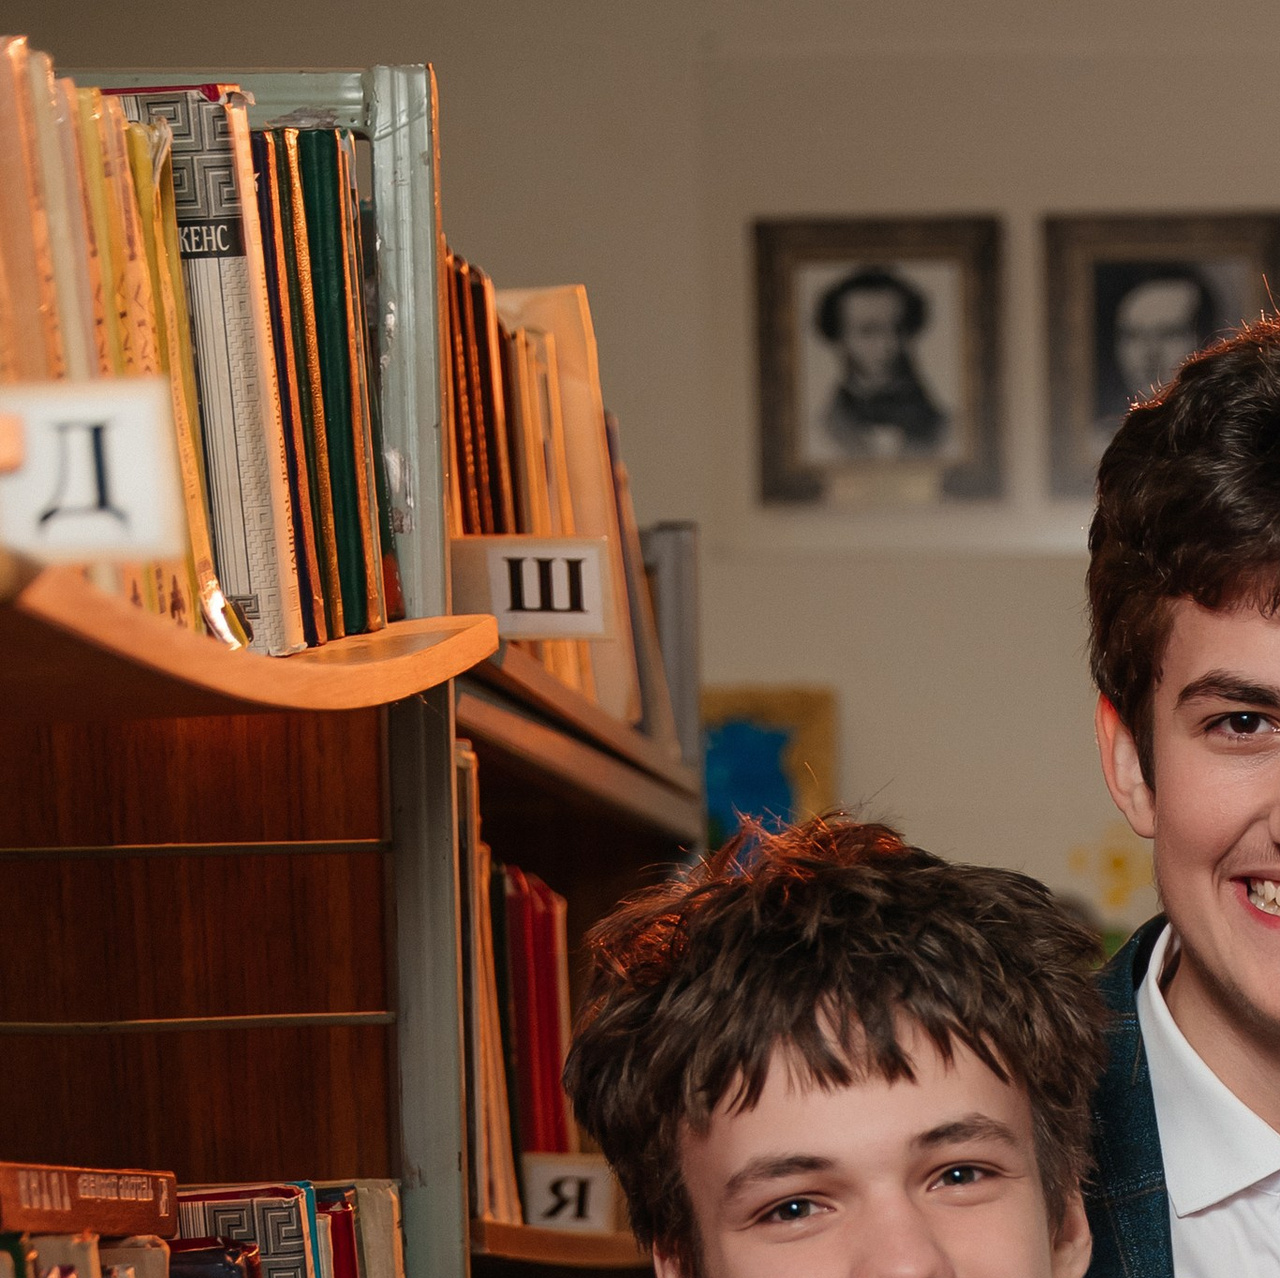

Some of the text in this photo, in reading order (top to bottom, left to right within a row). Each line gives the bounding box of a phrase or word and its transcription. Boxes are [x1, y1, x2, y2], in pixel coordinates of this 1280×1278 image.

[36, 417, 129, 538] Д
[503, 556, 590, 613] Ш
[544, 1175, 590, 1220] Я
